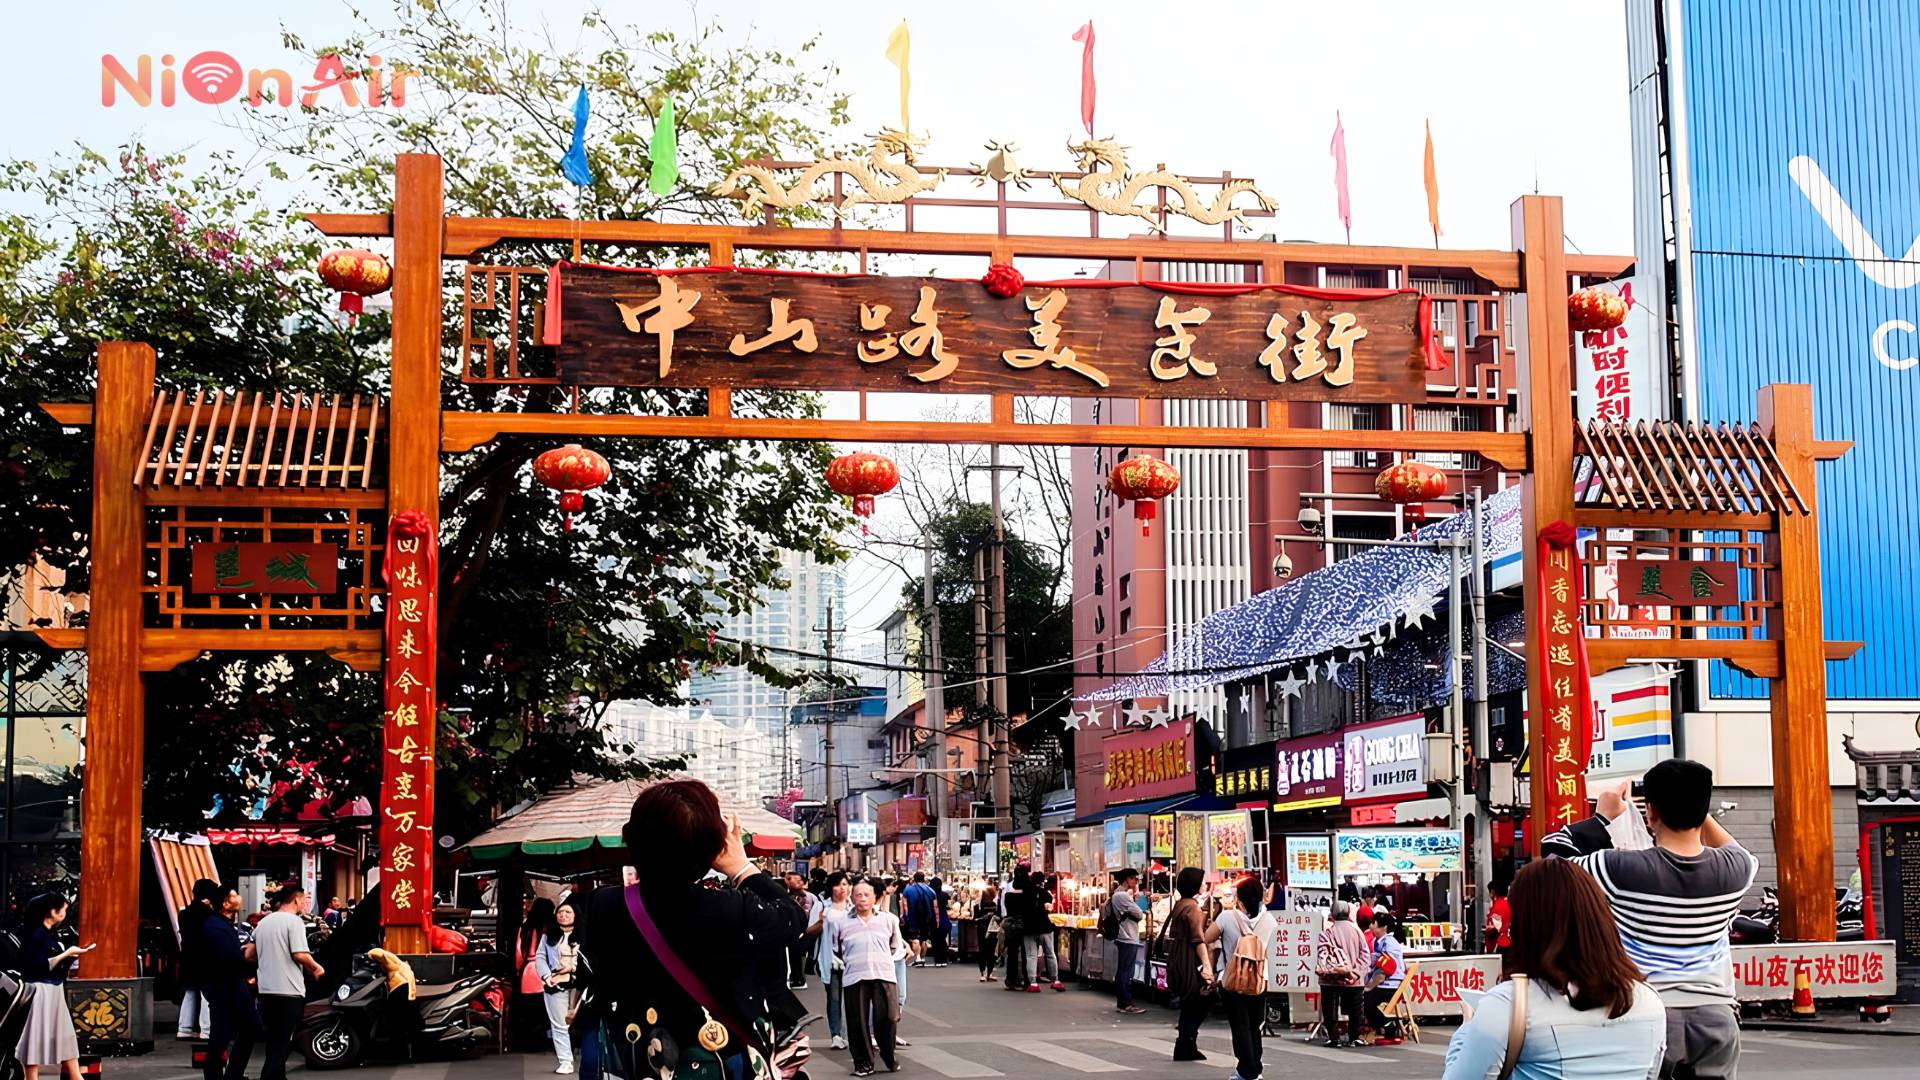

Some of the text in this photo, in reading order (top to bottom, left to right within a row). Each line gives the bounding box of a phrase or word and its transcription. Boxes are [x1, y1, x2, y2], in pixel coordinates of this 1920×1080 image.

[616, 274, 1368, 388] 中山路美食街
